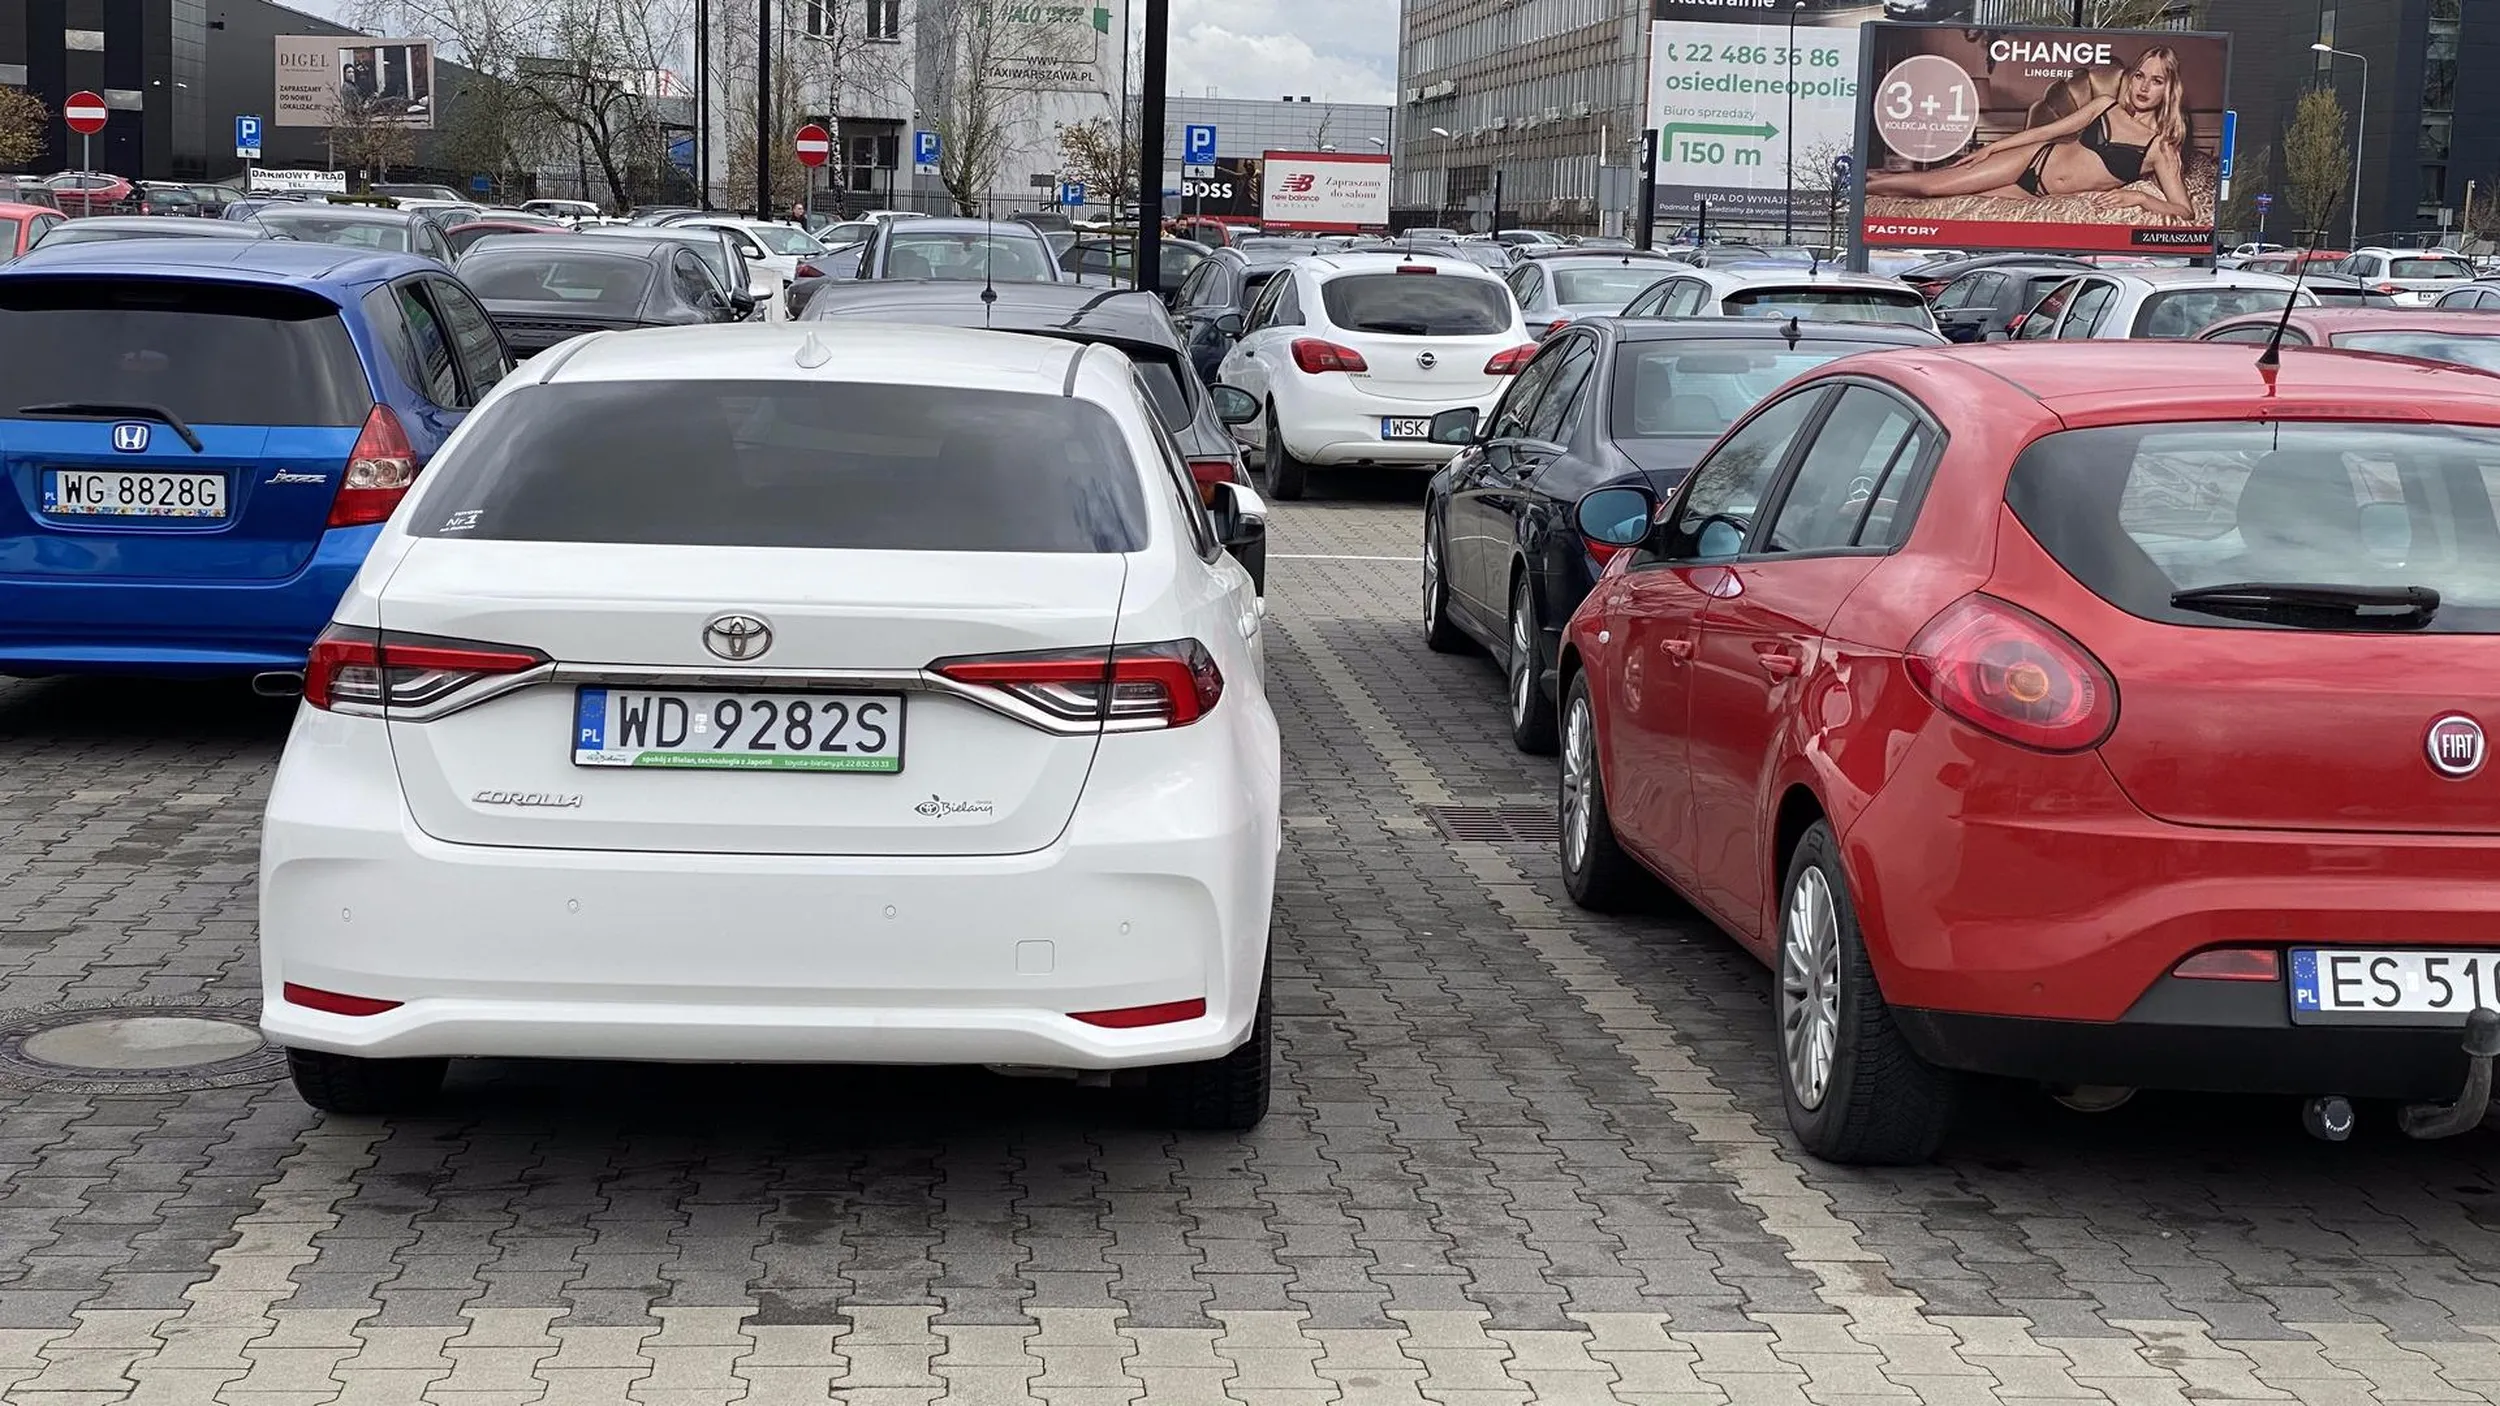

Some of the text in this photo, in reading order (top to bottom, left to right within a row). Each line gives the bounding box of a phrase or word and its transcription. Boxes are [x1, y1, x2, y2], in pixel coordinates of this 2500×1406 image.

[1669, 0, 1775, 8] urane
[280, 52, 330, 68] DIGEL
[1685, 43, 1840, 68] 22 486 36 86
[1989, 40, 2111, 65] CHANGE
[2024, 67, 2074, 79] LINGERIE
[280, 84, 322, 93] ZAPRASZAMY
[290, 94, 312, 102] NOWEJ
[1886, 81, 1970, 122] 3+1
[1664, 105, 1695, 116] Biuro
[242, 120, 256, 139] P
[1885, 121, 1927, 130] KOLEKCJA
[921, 133, 936, 154] P
[1192, 128, 1210, 152] P
[1680, 141, 1761, 166] 150 m
[1182, 181, 1233, 199] BOSS
[1325, 176, 1381, 190] Zapraszamy
[1288, 194, 1319, 202] balance
[1330, 189, 1377, 199] do salonu
[1693, 192, 1726, 202] BIURA
[1729, 194, 1745, 203] DO
[1868, 225, 1940, 235] FACTORY
[2142, 232, 2209, 244] ZAPRASZAMY
[1392, 420, 1425, 436] WSK
[45, 492, 56, 501] PL
[64, 475, 217, 507] WG 8828G
[618, 695, 889, 753] WD 9282S
[581, 729, 600, 742] PL
[2442, 733, 2474, 759] FIAT
[471, 790, 583, 809] COROLLA
[940, 801, 993, 816] Bielany
[2330, 956, 2500, 1009] ES 51
[2297, 989, 2317, 1003] PL
